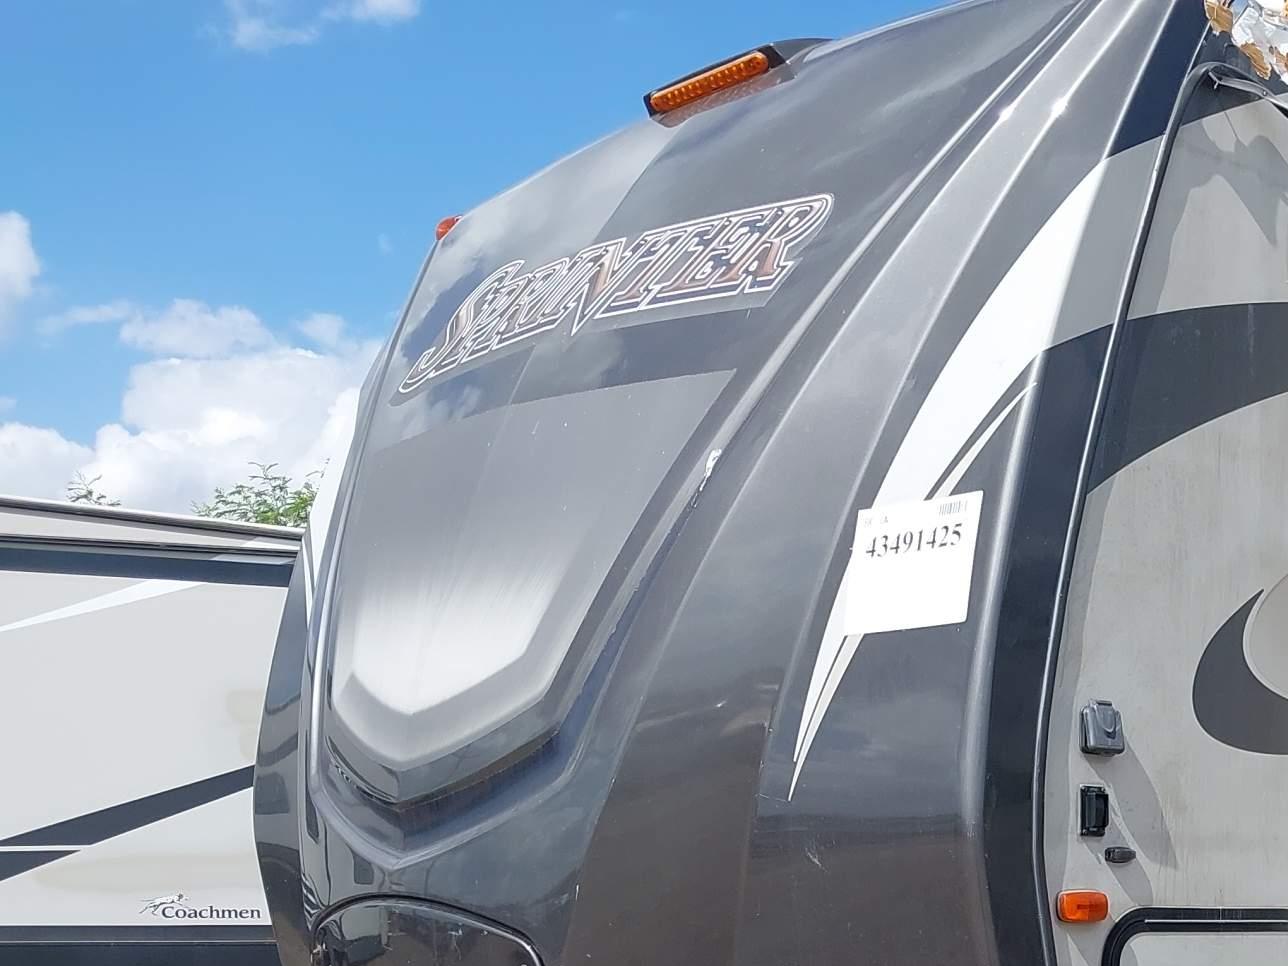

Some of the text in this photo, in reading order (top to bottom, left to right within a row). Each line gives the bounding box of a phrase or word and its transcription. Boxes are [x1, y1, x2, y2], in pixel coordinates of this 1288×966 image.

[402, 194, 833, 392] SPRINTER
[865, 522, 963, 558] 43491425
[161, 905, 261, 919] Coachmen
